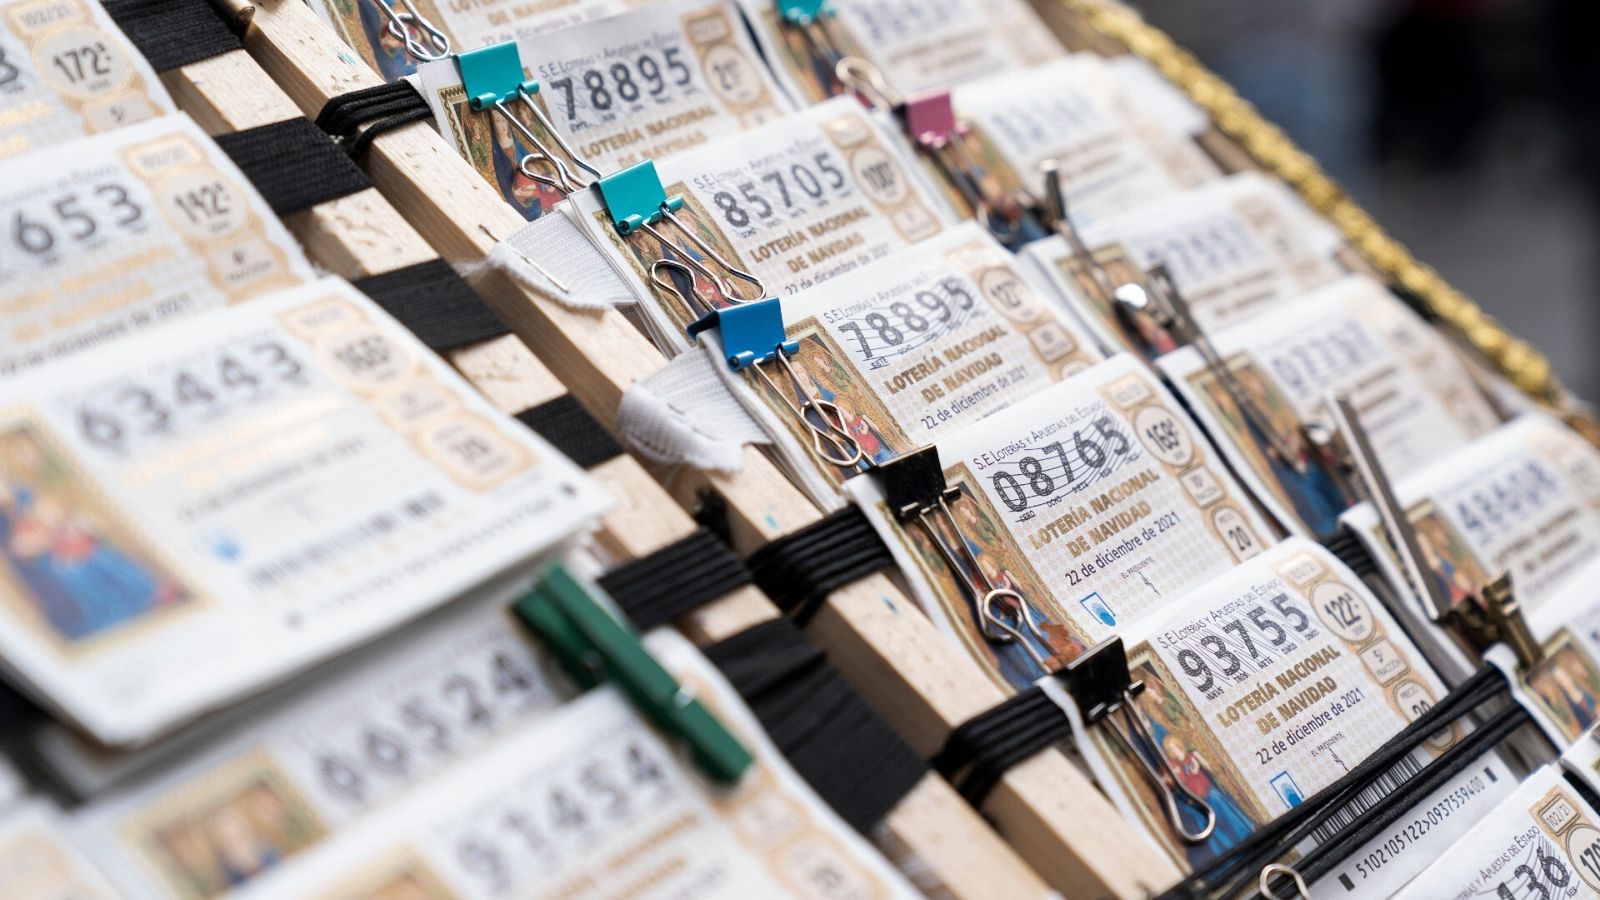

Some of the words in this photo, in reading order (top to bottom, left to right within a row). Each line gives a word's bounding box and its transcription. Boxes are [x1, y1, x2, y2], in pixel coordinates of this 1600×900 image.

[550, 47, 691, 121] 78895
[10, 184, 143, 256] 653
[714, 151, 844, 228] 85705
[749, 229, 808, 264] LOTERÍA
[786, 254, 807, 273] DE
[838, 277, 974, 359] 78895
[884, 349, 945, 394] LOTERÍA
[943, 325, 1008, 363] NACIONAL
[920, 384, 943, 404] DE
[945, 352, 1003, 388] NAVIDAD
[75, 342, 306, 450] 63443
[920, 413, 938, 430] 22
[936, 405, 952, 421] de
[953, 383, 997, 414] diciembre
[992, 416, 1129, 512] 08765
[1028, 506, 1093, 550] LOTERÍA
[1089, 468, 1160, 515] NACIONAL
[1065, 535, 1091, 558] DE
[1088, 500, 1152, 546] NAVIDAD
[1228, 525, 1252, 552] 20
[1065, 569, 1082, 586] 22
[1081, 563, 1097, 578] de
[1100, 535, 1143, 569] diciembre
[1143, 527, 1157, 542] de
[1154, 511, 1181, 534] 2021
[1209, 597, 1246, 623] APUESTAS
[1178, 592, 1309, 693] 93755
[1216, 681, 1280, 728] LOTERÍA
[1275, 644, 1342, 691] NACIONAL
[1233, 671, 1251, 684] TRES
[1255, 711, 1281, 736] DE
[1277, 675, 1338, 722] NAVIDAD
[1256, 748, 1273, 765] 22
[1272, 738, 1288, 755] de
[1286, 710, 1333, 746] diciembre
[1331, 701, 1345, 717] de
[1340, 687, 1365, 710] 2021
[1356, 776, 1485, 879] 5102105122>0937559400
[1513, 825, 1541, 849] ESTADO
[1545, 803, 1572, 828] 102/21
[1479, 853, 1512, 883] APUESTAS
[1507, 845, 1521, 858] DEL
[1566, 886, 1578, 899] SEIS
